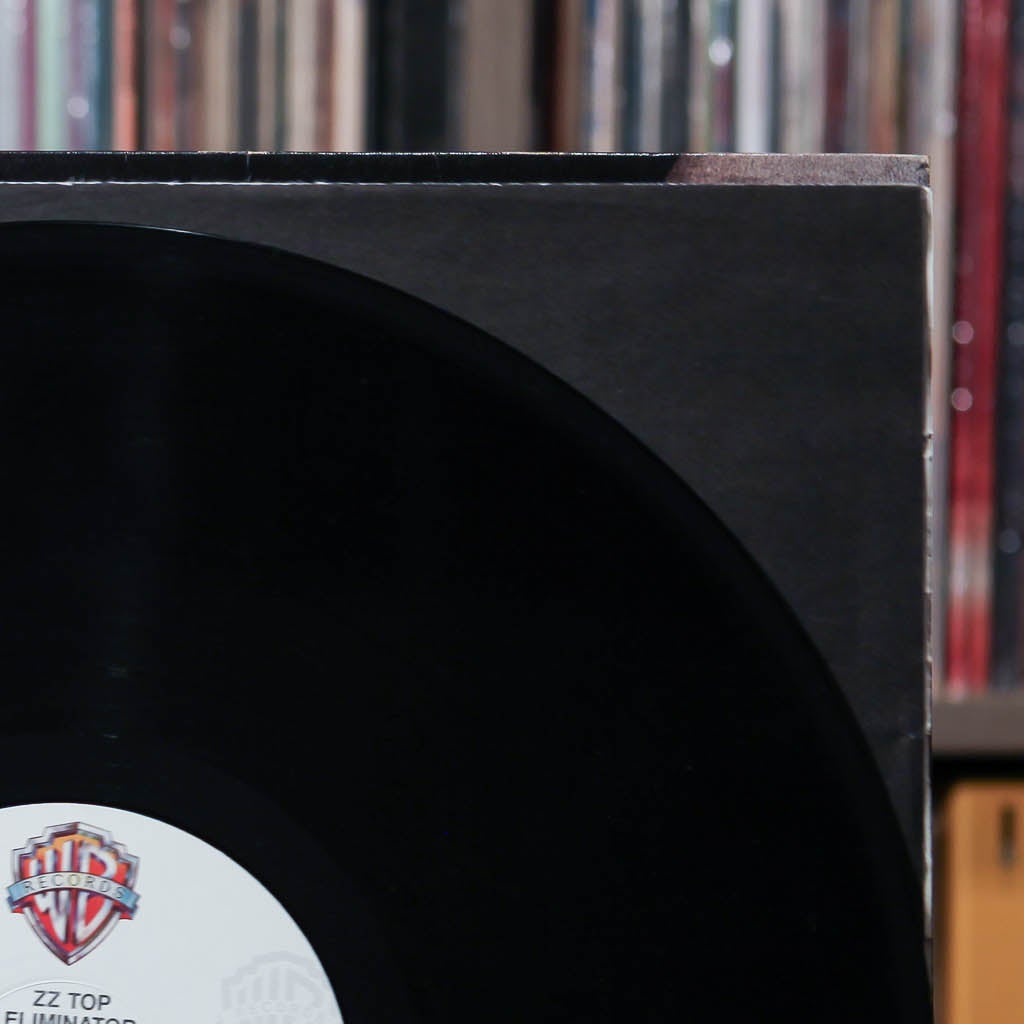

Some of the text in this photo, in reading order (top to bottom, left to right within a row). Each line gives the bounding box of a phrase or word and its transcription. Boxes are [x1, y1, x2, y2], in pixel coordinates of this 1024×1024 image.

[22, 873, 127, 899] RECORDS
[33, 990, 112, 1011] ZZ TOP
